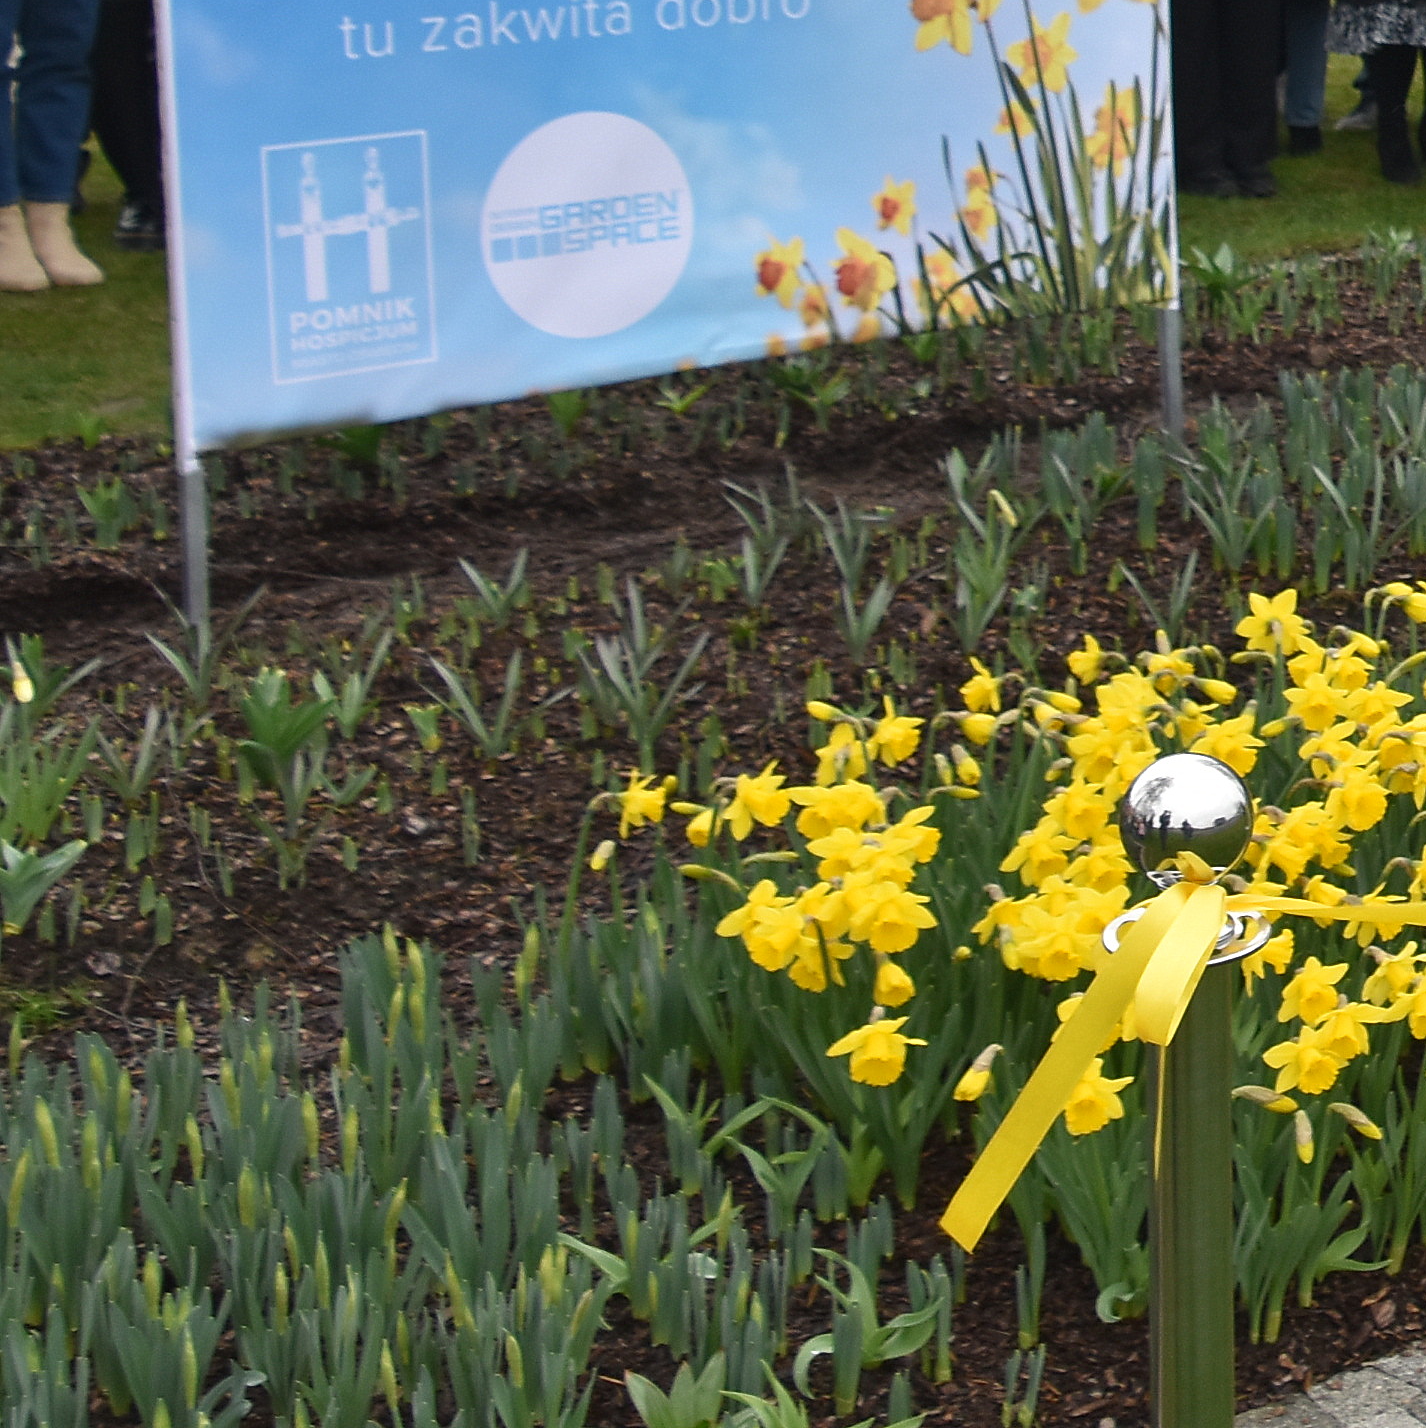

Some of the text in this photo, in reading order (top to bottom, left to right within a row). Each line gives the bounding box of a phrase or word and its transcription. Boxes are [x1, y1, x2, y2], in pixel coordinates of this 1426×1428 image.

[338, 16, 394, 59] tu
[539, 190, 679, 230] GARDEN
[565, 215, 681, 254] SPACE
[291, 297, 416, 334] POMNIK
